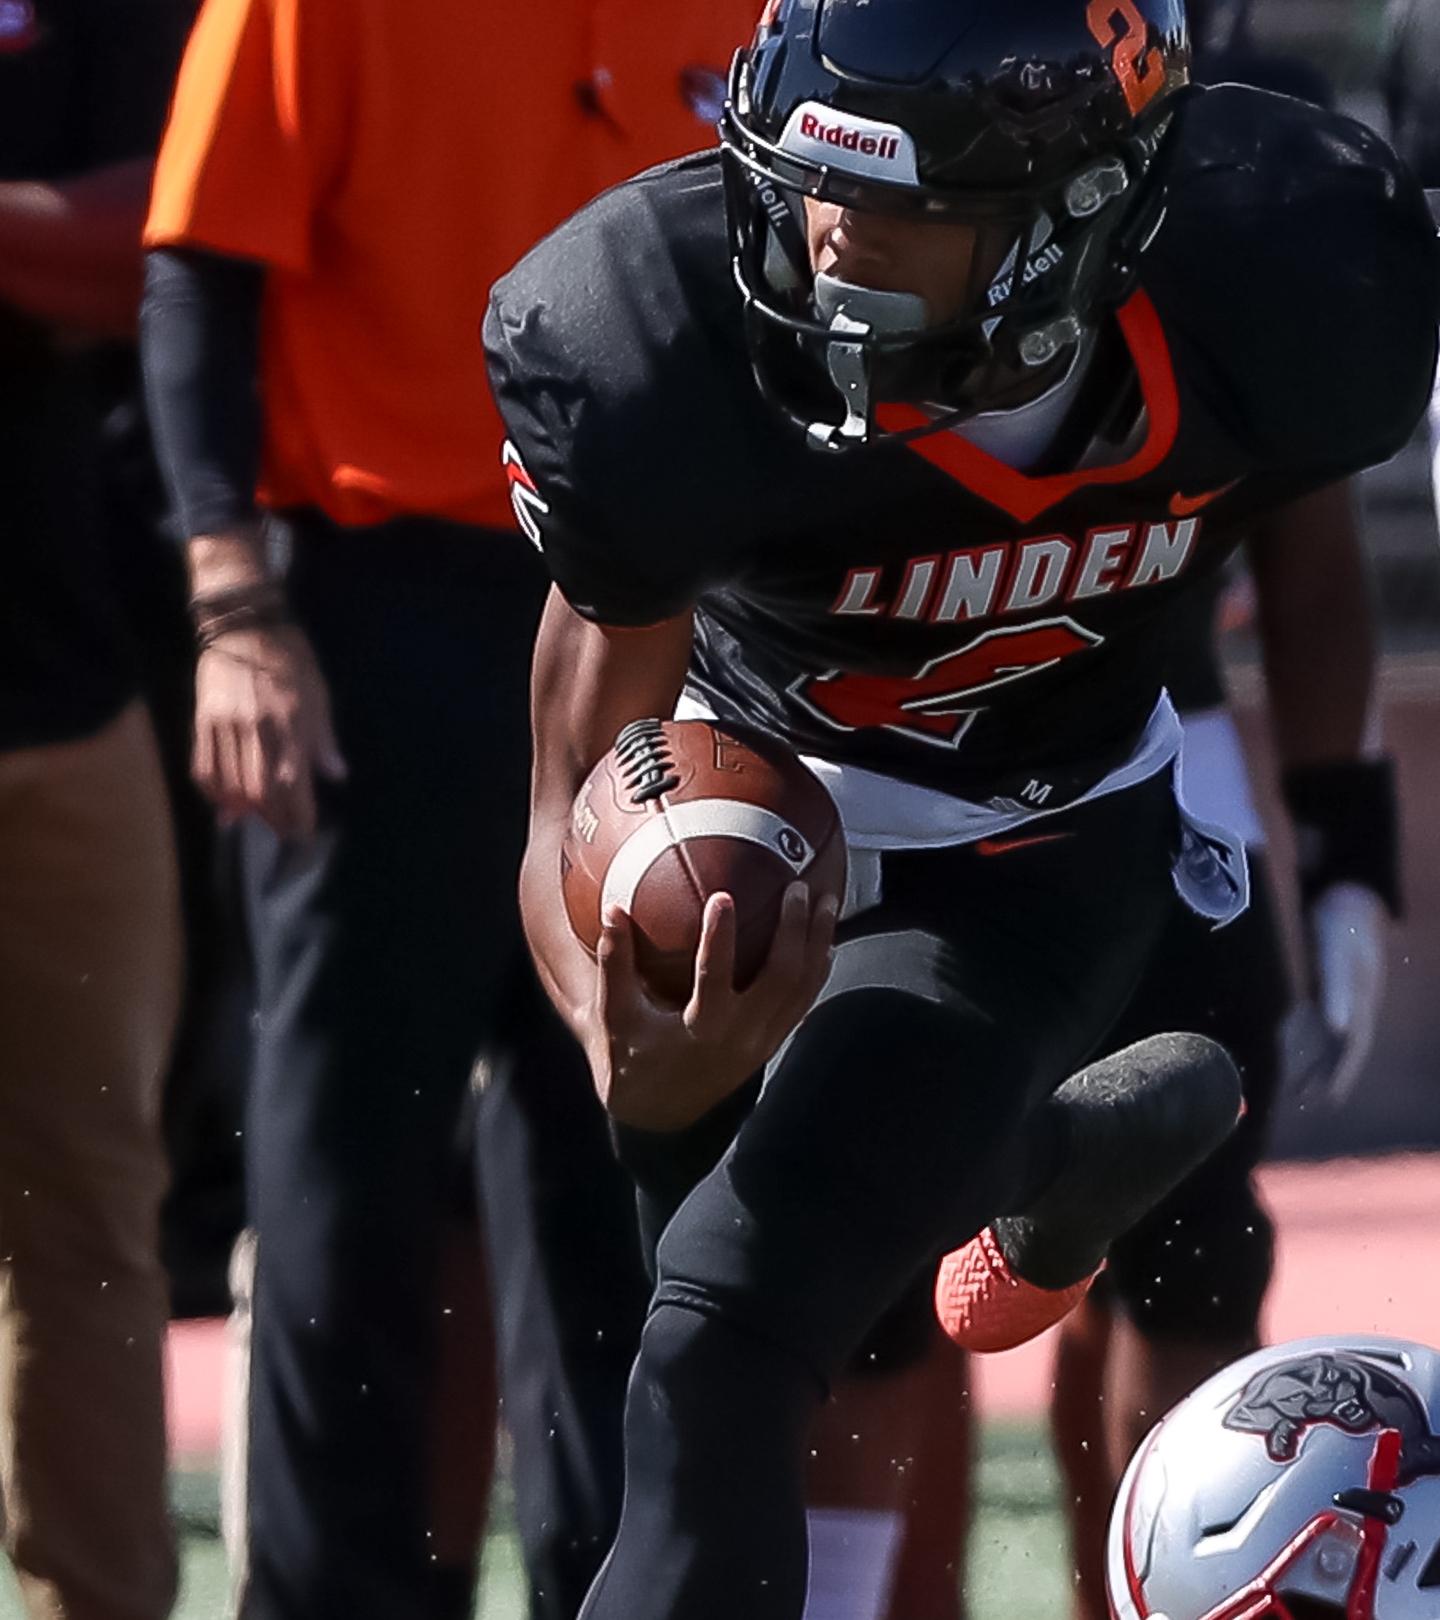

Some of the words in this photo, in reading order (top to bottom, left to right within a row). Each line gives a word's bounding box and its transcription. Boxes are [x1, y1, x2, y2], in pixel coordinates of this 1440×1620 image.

[1086, 0, 1166, 117] 2
[800, 112, 899, 160] Riddell
[829, 517, 1200, 624] LINDEN
[786, 615, 1106, 750] 2
